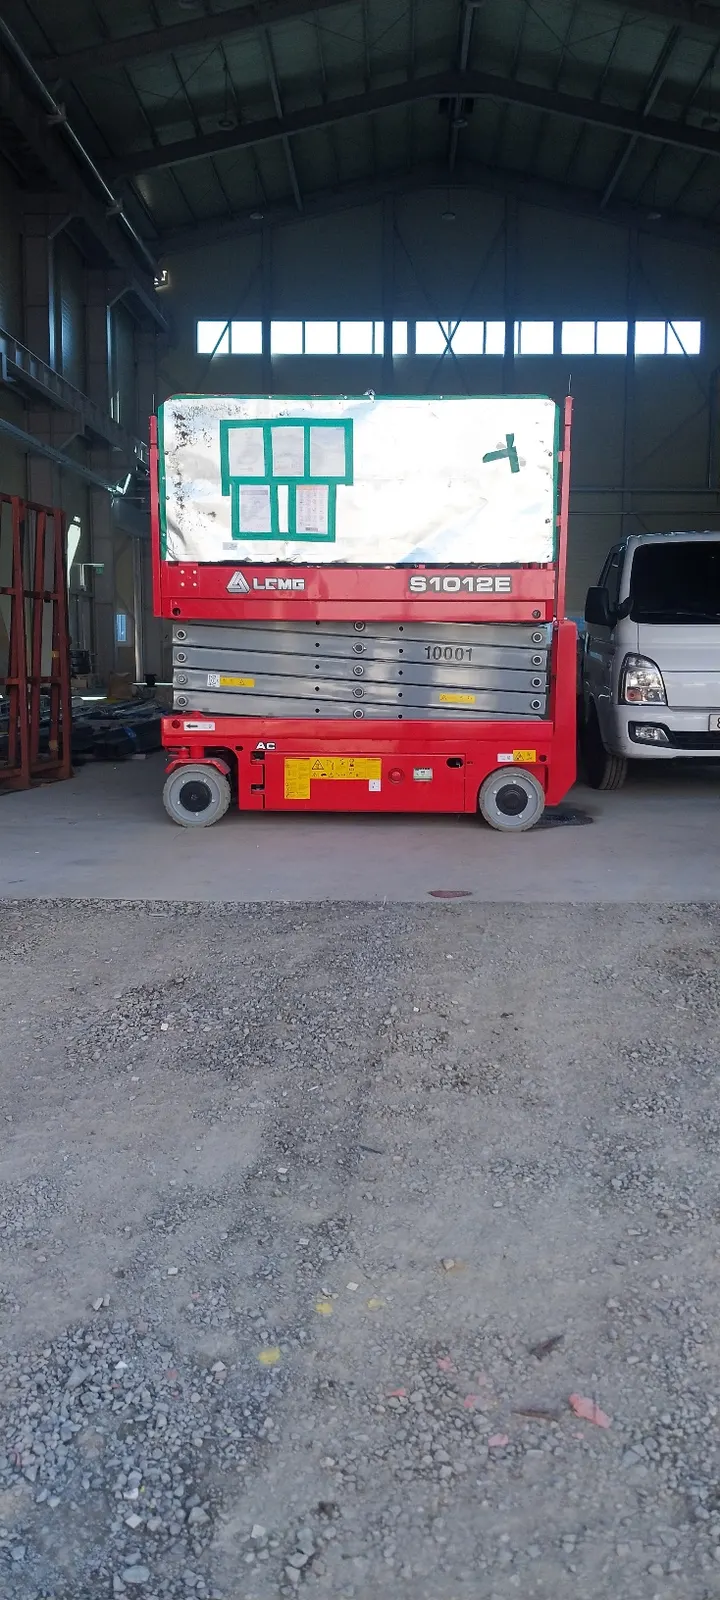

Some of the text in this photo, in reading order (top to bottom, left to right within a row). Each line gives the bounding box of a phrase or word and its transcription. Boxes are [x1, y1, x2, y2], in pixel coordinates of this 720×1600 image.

[408, 576, 512, 593] S1012E
[424, 645, 474, 662] 10001
[255, 741, 276, 751] AC
